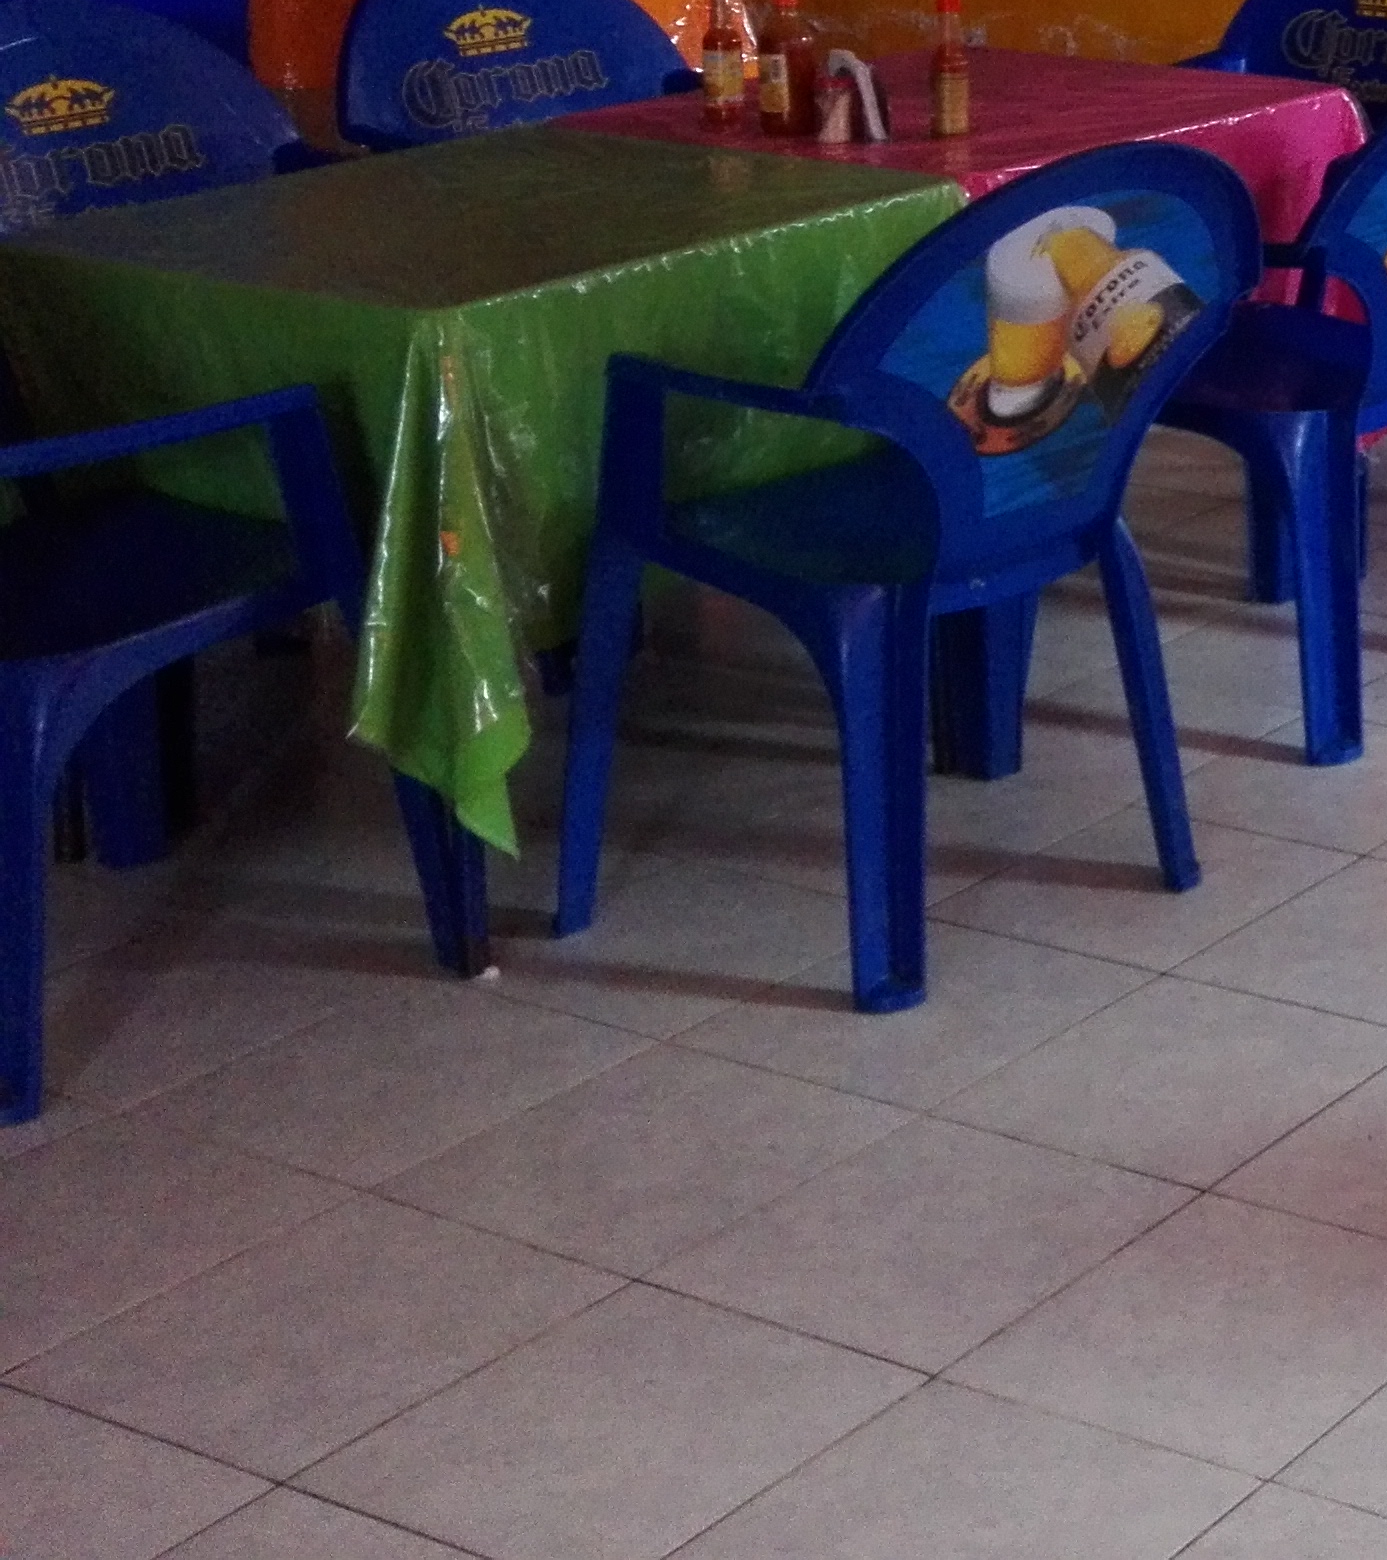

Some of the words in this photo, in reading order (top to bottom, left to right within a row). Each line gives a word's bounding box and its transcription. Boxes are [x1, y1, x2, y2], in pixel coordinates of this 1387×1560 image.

[402, 49, 610, 130] Corona
[0, 124, 207, 204] orona
[1073, 260, 1149, 342] Corona
